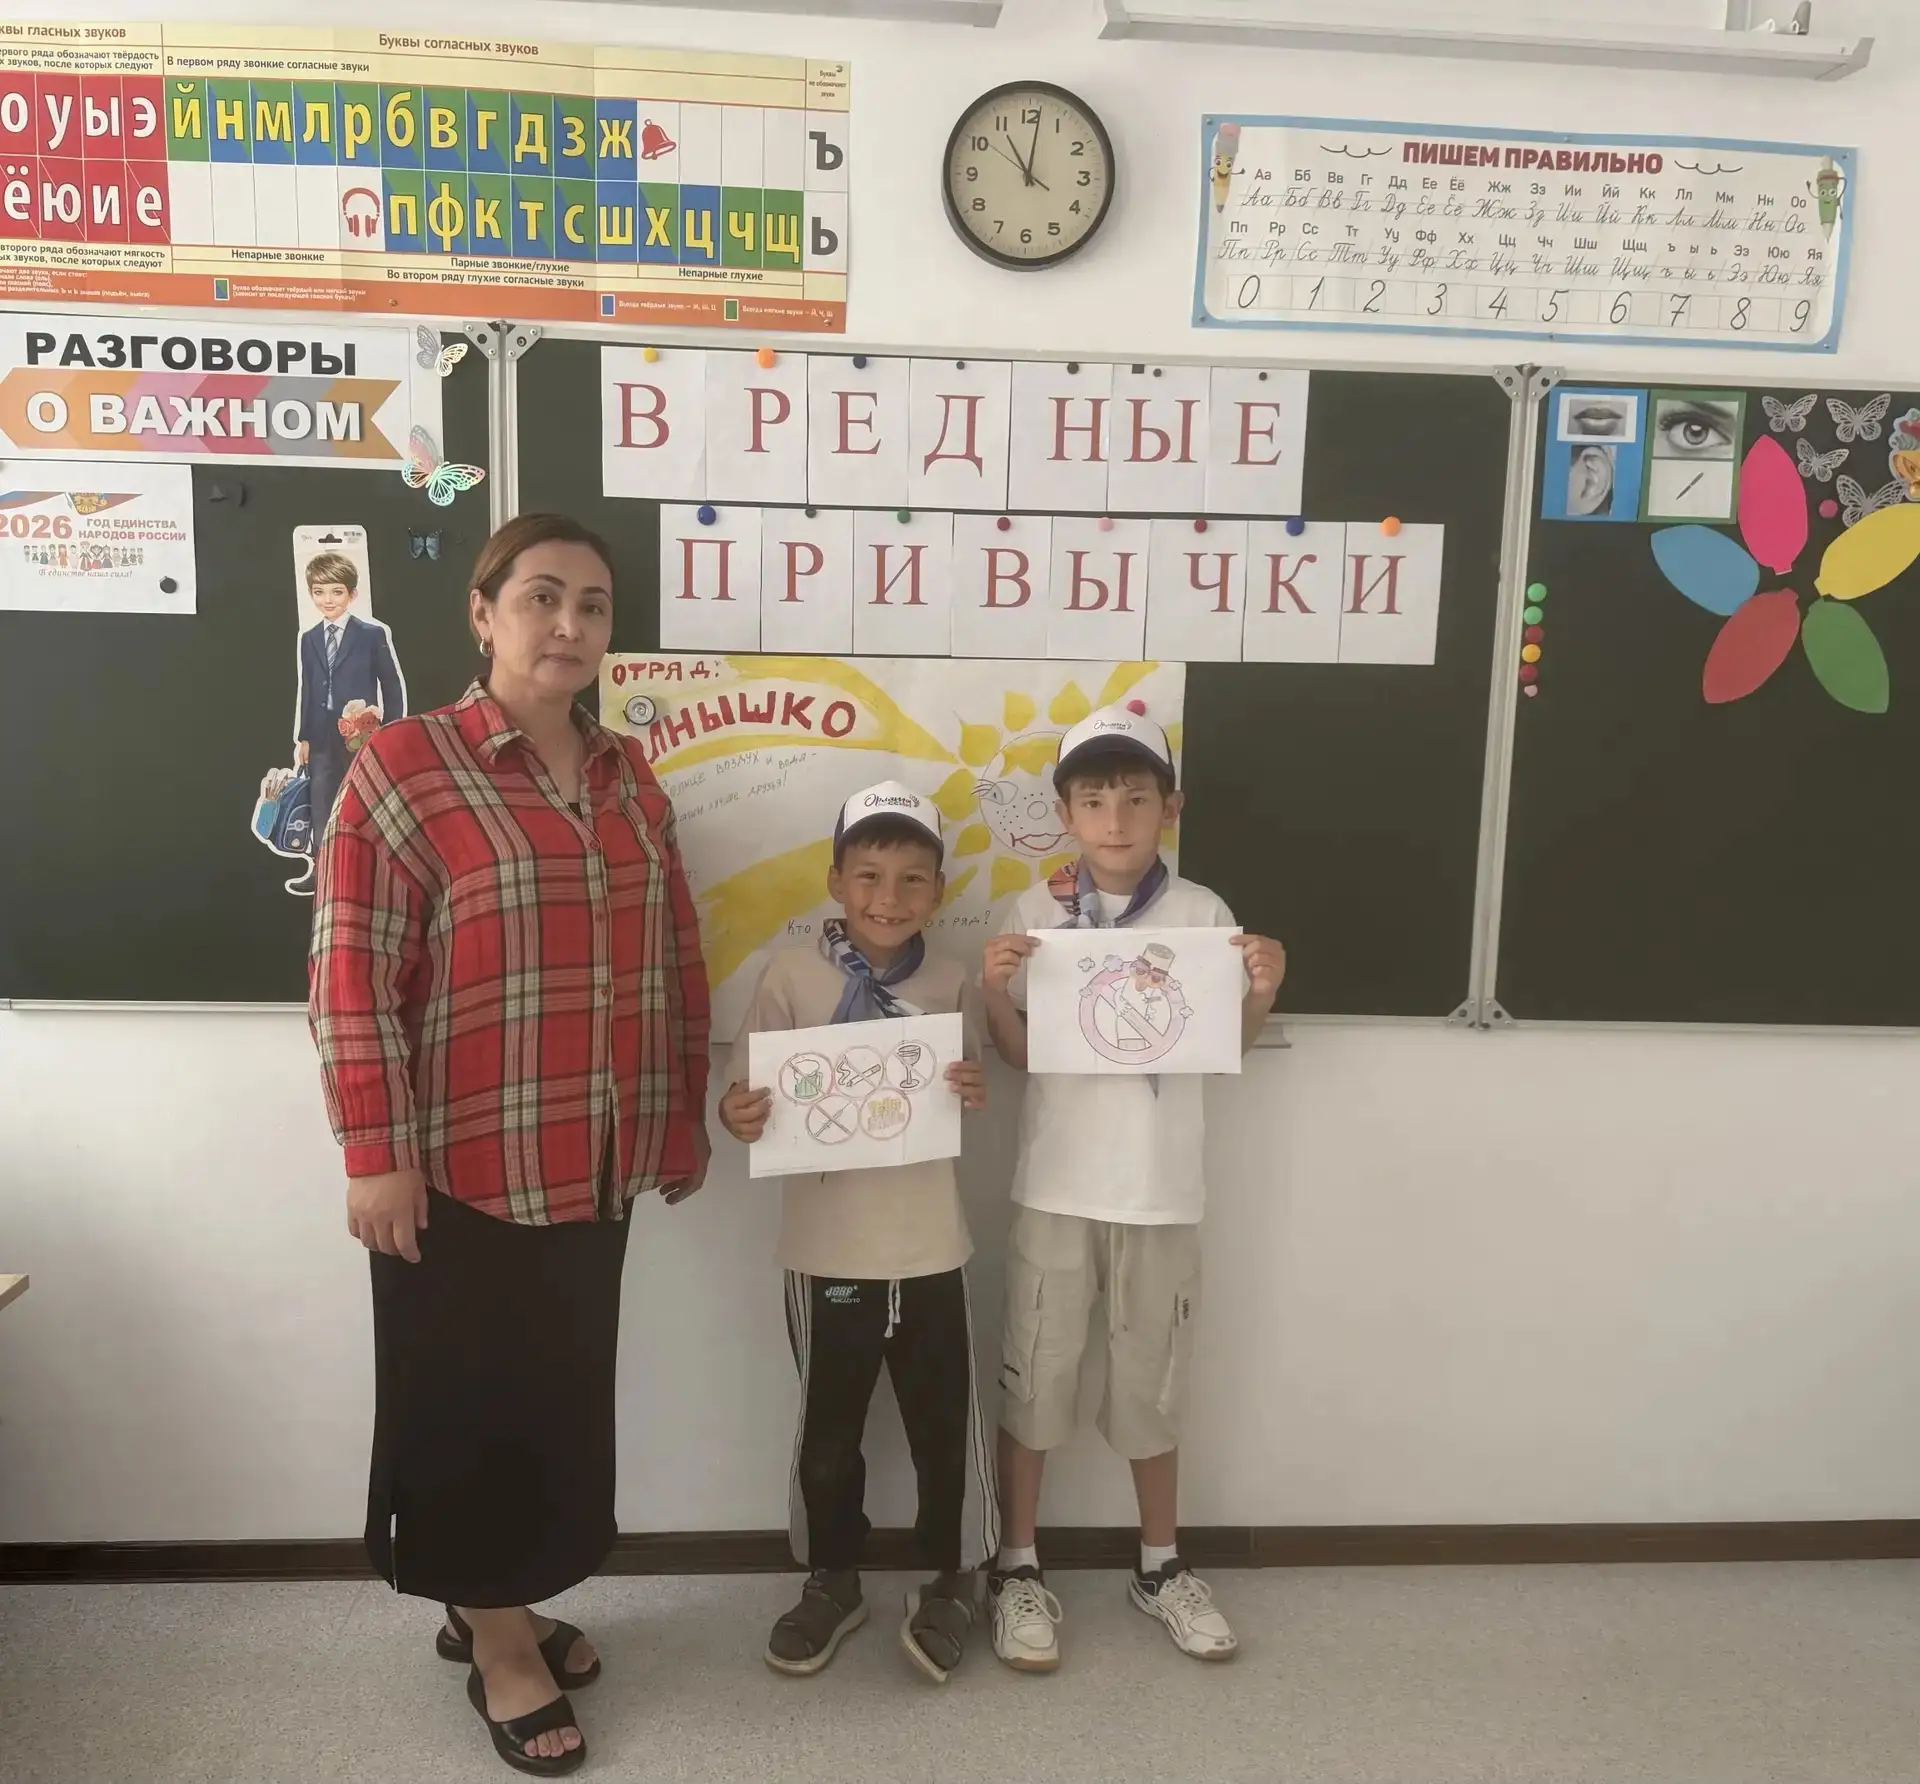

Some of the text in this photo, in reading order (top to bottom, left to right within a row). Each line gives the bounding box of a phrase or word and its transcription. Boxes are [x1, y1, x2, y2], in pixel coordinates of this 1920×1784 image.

[0, 25, 126, 40] квы гласных звуков
[379, 34, 539, 57] Буквы согласных звуков
[31, 50, 54, 59] ряда
[57, 50, 111, 60] обозначают
[113, 51, 160, 61] твёрдость
[75, 61, 112, 70] которых
[115, 62, 153, 71] следуют
[167, 55, 370, 73] В первом ряду звонкие согласные звуки
[996, 115, 1008, 131] 11
[1021, 109, 1040, 125] 12
[1055, 118, 1060, 134] 1
[971, 136, 989, 151] 10
[1070, 141, 1084, 156] 2
[1403, 142, 1663, 174] ПИШЕМ ПРАВИЛЬНО
[966, 166, 978, 181] 9
[1076, 171, 1091, 186] 3
[1254, 169, 1807, 209] Аа Бб Вв Гг Дд Ее Ёё Жж Зз Ии Йй Кк Лл Мм Нн Оо
[972, 198, 986, 211] 8
[1069, 200, 1081, 215] 4
[993, 221, 1004, 234] 7
[1047, 222, 1061, 235] 5
[1020, 229, 1032, 244] 6
[1230, 221, 1248, 234] Пп
[1269, 222, 1286, 236] Рр
[1302, 223, 1319, 235] Сс
[1345, 225, 1359, 238] Тт
[1384, 228, 1399, 243] Уу
[1415, 229, 1437, 245] Фф
[1459, 232, 1475, 245] Хх
[1499, 234, 1516, 248] Цц
[1538, 236, 1553, 249] Чч
[1574, 238, 1597, 250] Шш
[1622, 239, 1647, 253] Щщ
[1734, 245, 1750, 257] Ээ
[1767, 246, 1790, 260] Юю
[1807, 249, 1823, 261] Яя
[0, 244, 166, 260] второго ряда обозначают мягкость
[231, 249, 325, 262] Непарные звонкие
[14, 255, 48, 264] звуков,
[51, 256, 79, 265] после
[82, 258, 121, 267] которых
[123, 260, 162, 269] следуют
[451, 257, 570, 273] Парные звонкие/глухие
[387, 269, 585, 288] Во втором ряду глухие согласные звуки
[678, 268, 764, 282] Непарные глухие
[1237, 274, 1811, 332] 0 1 2 3 4 5 6 7 8 9
[25, 332, 357, 376] РАЗГОВОРЫ
[26, 391, 362, 442] О ВАЖНОМ
[0, 514, 73, 539] 2026
[86, 518, 177, 529] ГОД ЕДИНСТВА
[78, 530, 187, 541] НАРОДОВ РОССИИ
[647, 690, 856, 764] ЛНЫШКО
